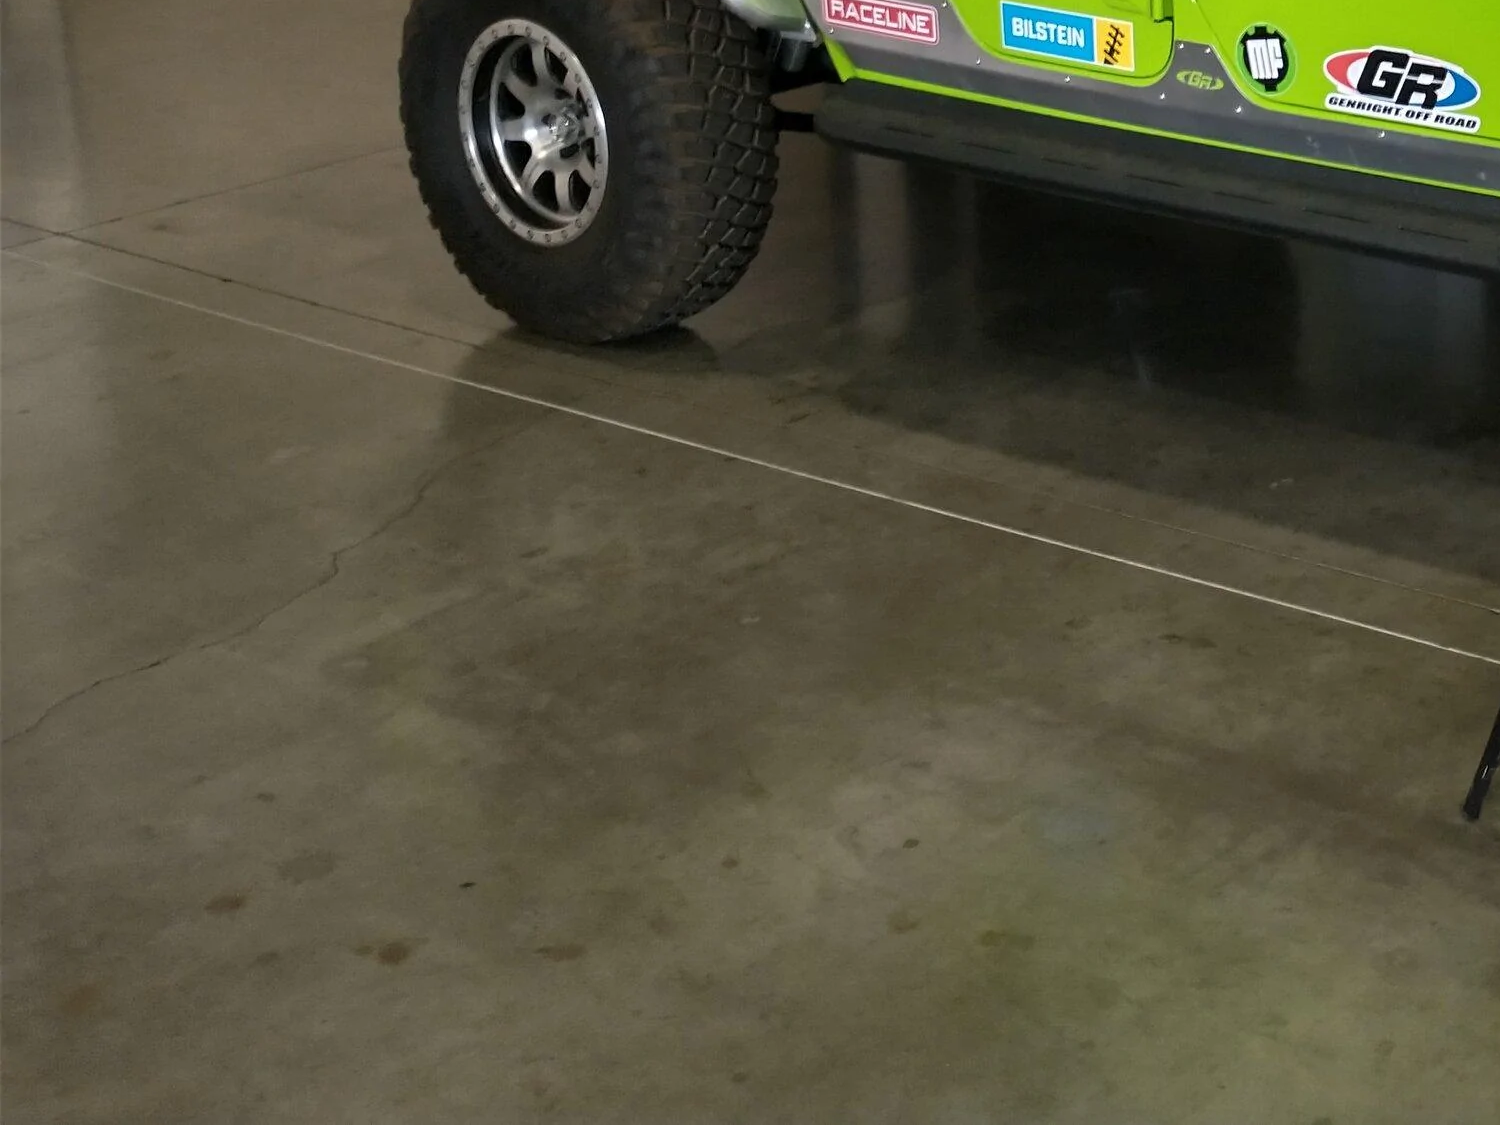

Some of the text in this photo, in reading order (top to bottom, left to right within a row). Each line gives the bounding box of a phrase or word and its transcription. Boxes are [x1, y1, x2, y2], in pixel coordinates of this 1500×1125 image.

[829, 0, 930, 34] RACELINE
[1011, 16, 1085, 48] BILSTEIN
[1357, 49, 1448, 110] GR
[1328, 95, 1477, 129] GENRIGHT OFF ROAD
